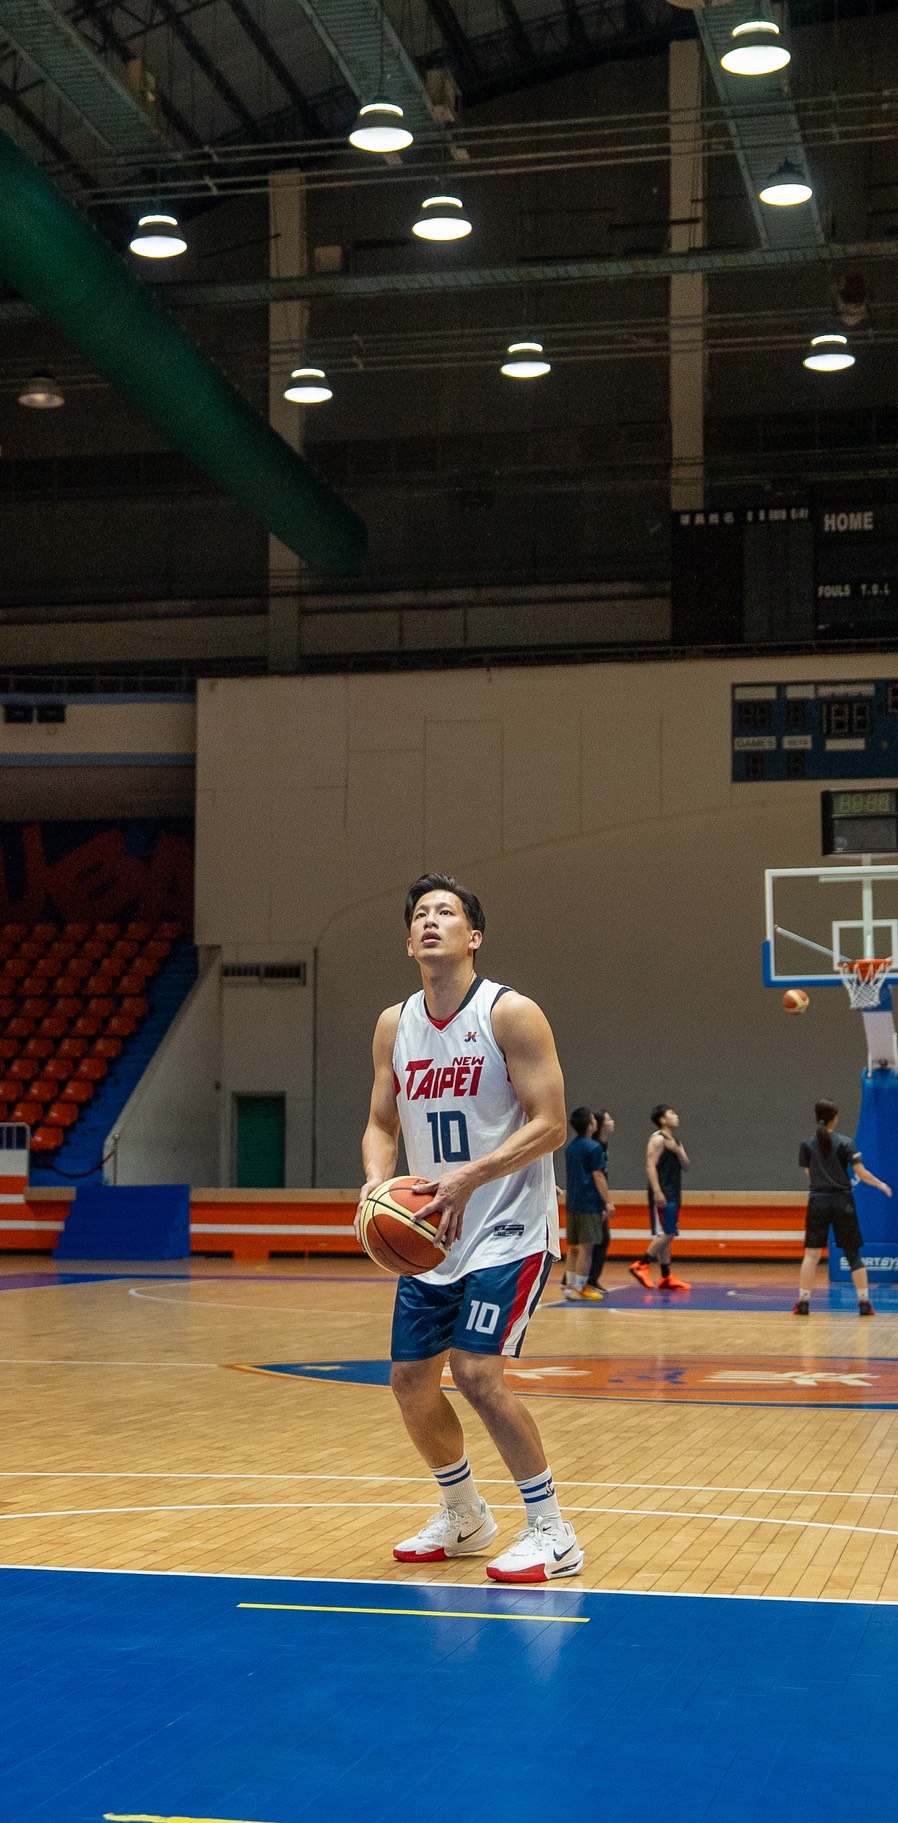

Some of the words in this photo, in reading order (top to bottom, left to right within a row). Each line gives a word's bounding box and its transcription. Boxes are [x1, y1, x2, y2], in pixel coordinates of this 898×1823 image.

[823, 511, 874, 532] HOME
[818, 584, 851, 598] FOULS
[736, 737, 774, 747] GAMES
[452, 1056, 485, 1066] NEW
[405, 1059, 483, 1101] TAIPEI
[426, 1110, 471, 1164] 10
[465, 1299, 501, 1335] 10
